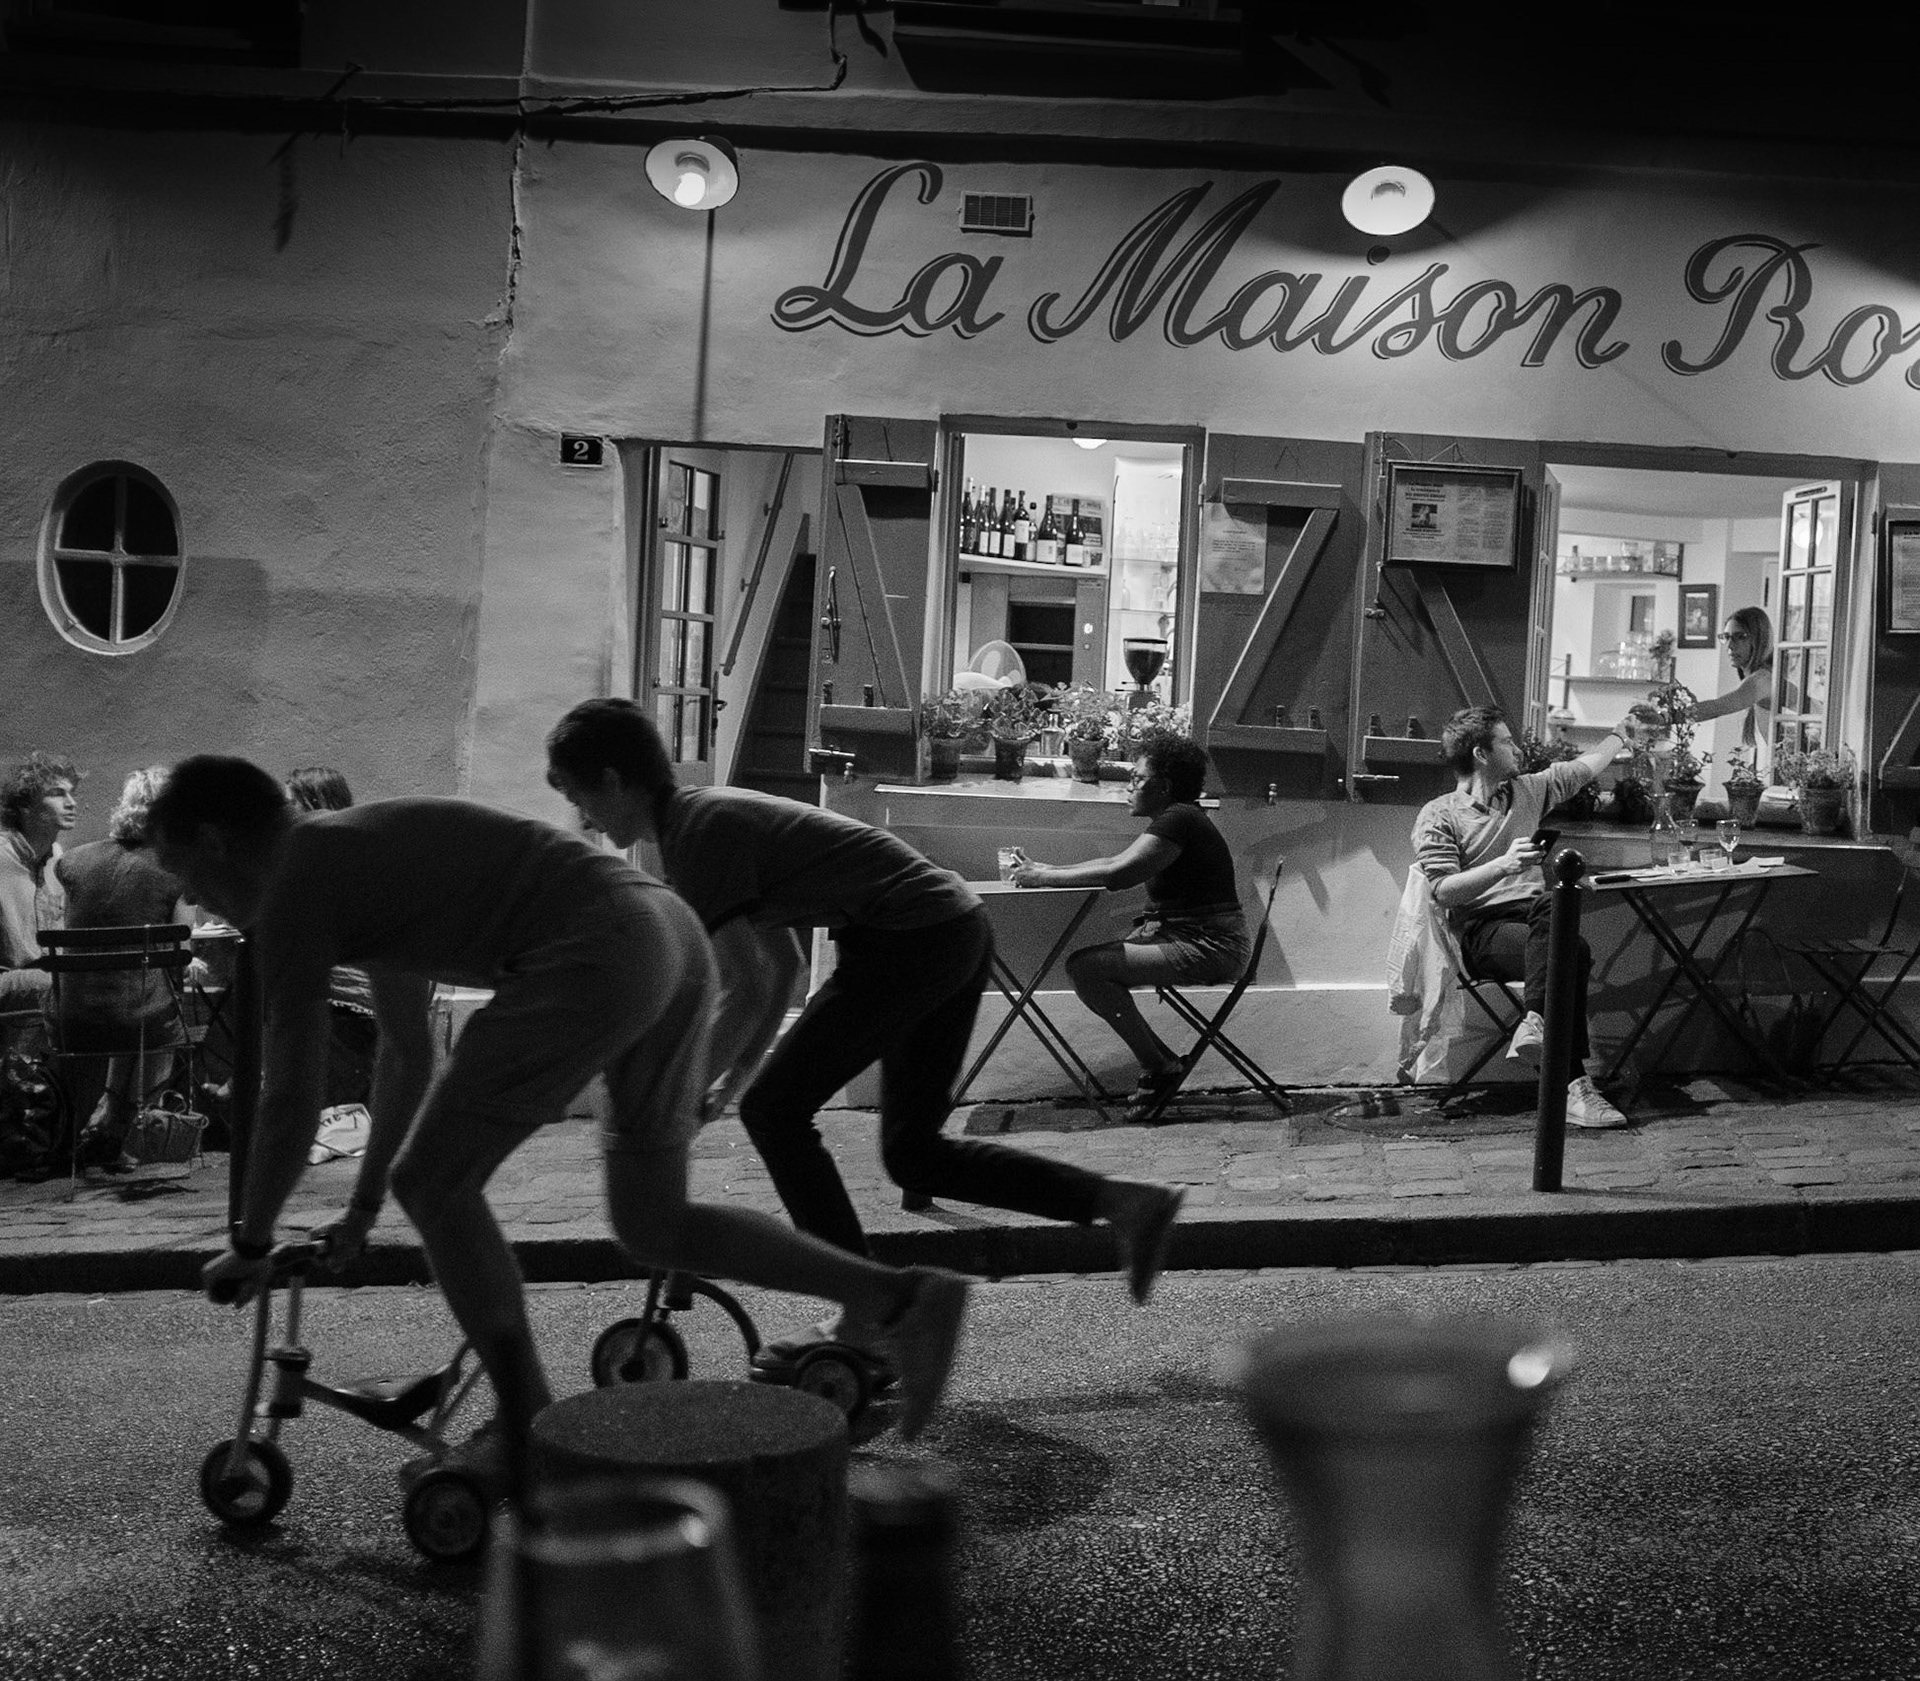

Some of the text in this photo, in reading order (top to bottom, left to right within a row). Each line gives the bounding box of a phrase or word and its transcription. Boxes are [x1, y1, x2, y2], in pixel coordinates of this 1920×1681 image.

[770, 161, 1920, 390] La Maison Ro
[573, 440, 589, 460] 2
